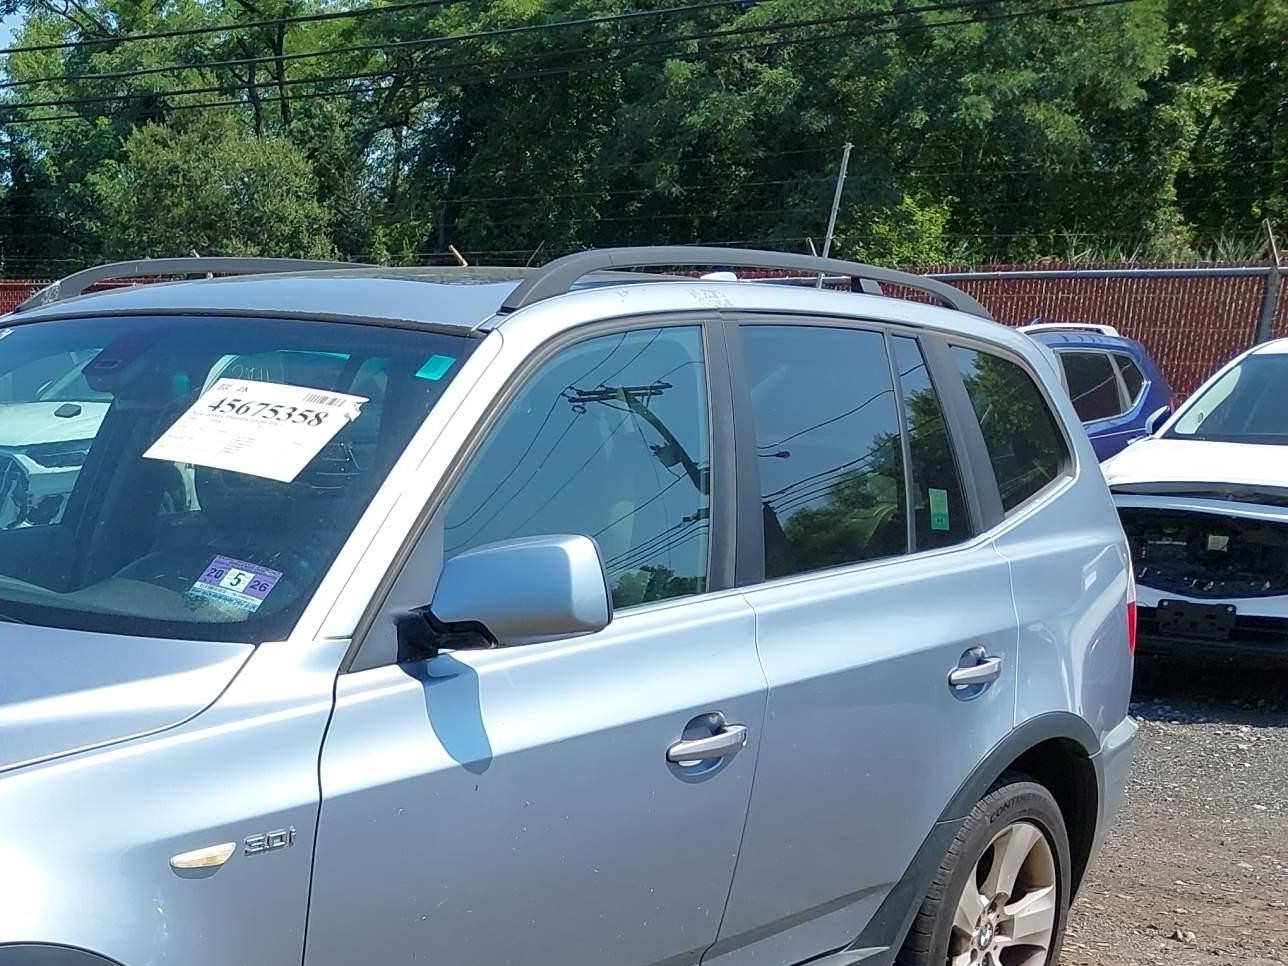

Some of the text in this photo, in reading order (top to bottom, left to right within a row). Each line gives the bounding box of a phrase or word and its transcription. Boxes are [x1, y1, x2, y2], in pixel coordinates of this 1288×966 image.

[207, 396, 330, 428] 45675358
[206, 567, 225, 580] 20
[229, 572, 246, 587] 5
[249, 579, 270, 593] 26
